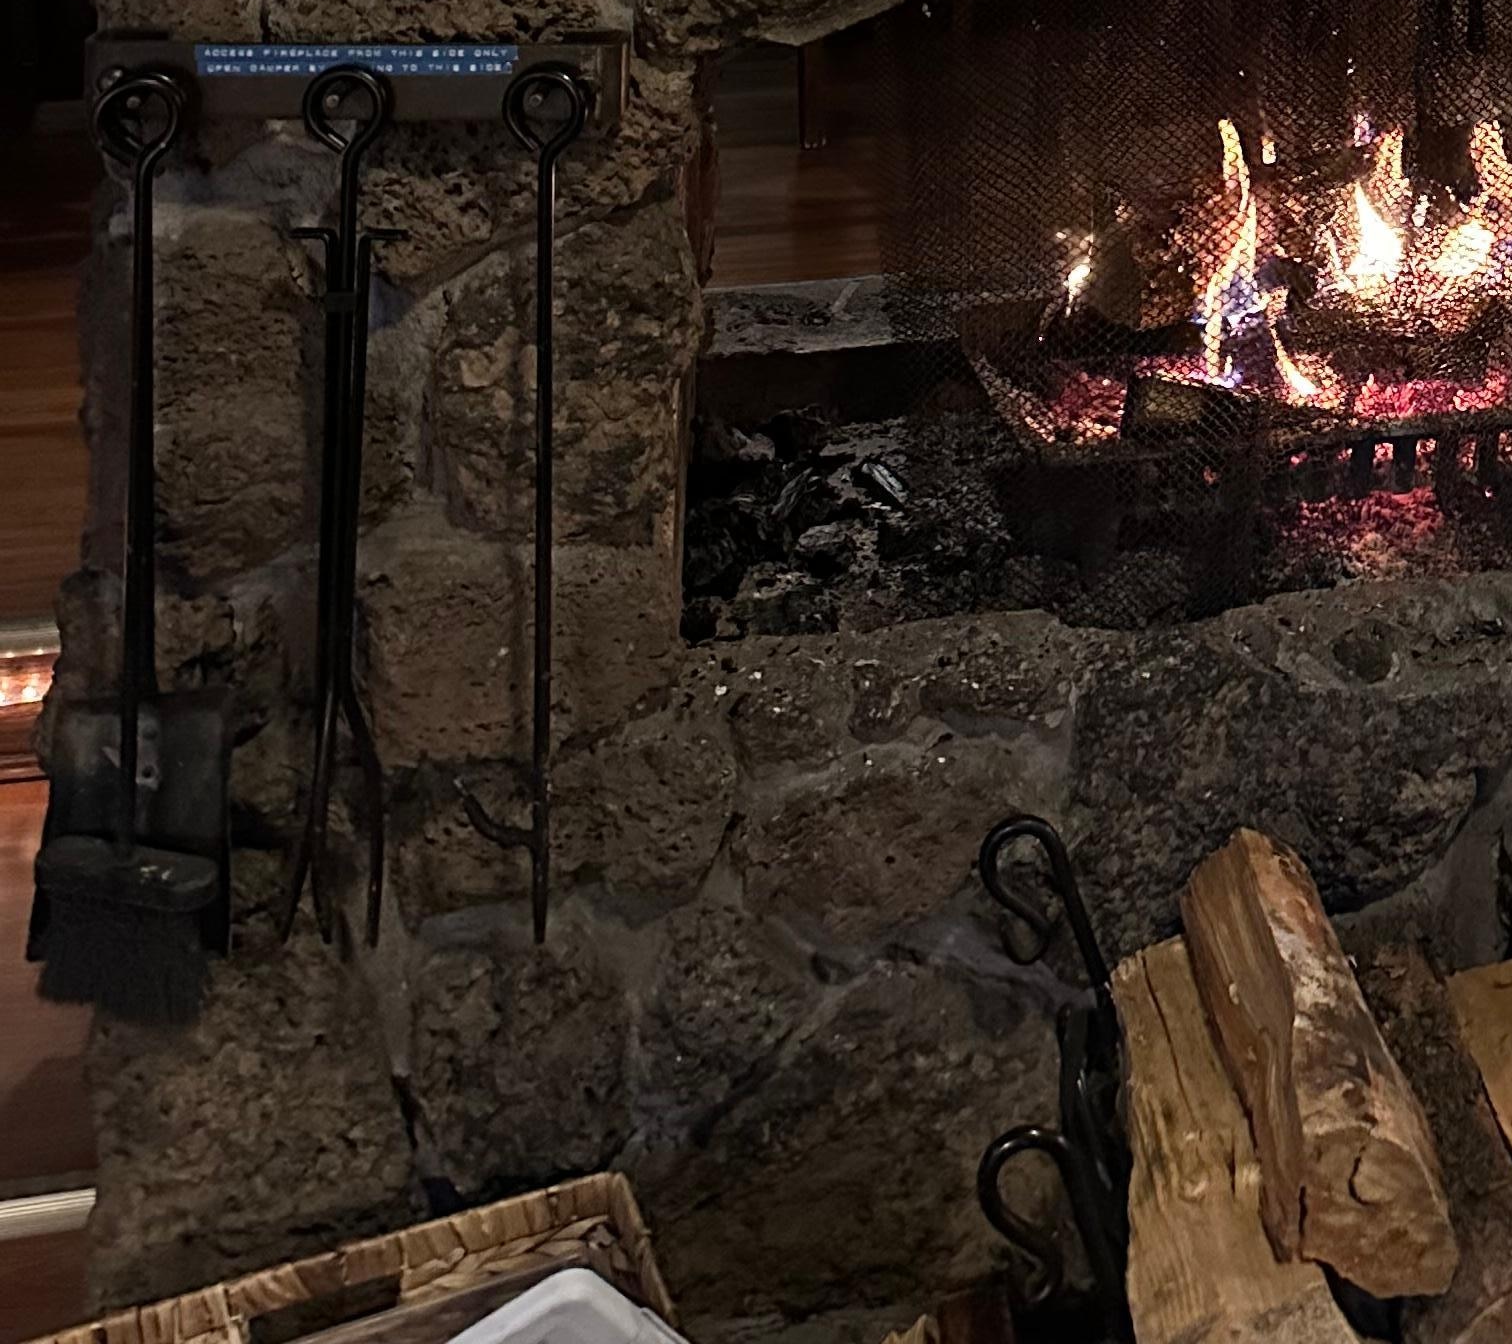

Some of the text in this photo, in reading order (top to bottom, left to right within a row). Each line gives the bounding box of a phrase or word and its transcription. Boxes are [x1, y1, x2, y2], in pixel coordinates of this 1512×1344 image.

[204, 48, 508, 58] ACCESS FIREPLACE FROM THIS SIDE ONLY
[207, 64, 241, 73] OPEN
[402, 63, 418, 73] TO
[428, 63, 460, 73] THIS
[469, 63, 502, 73] SIDE
